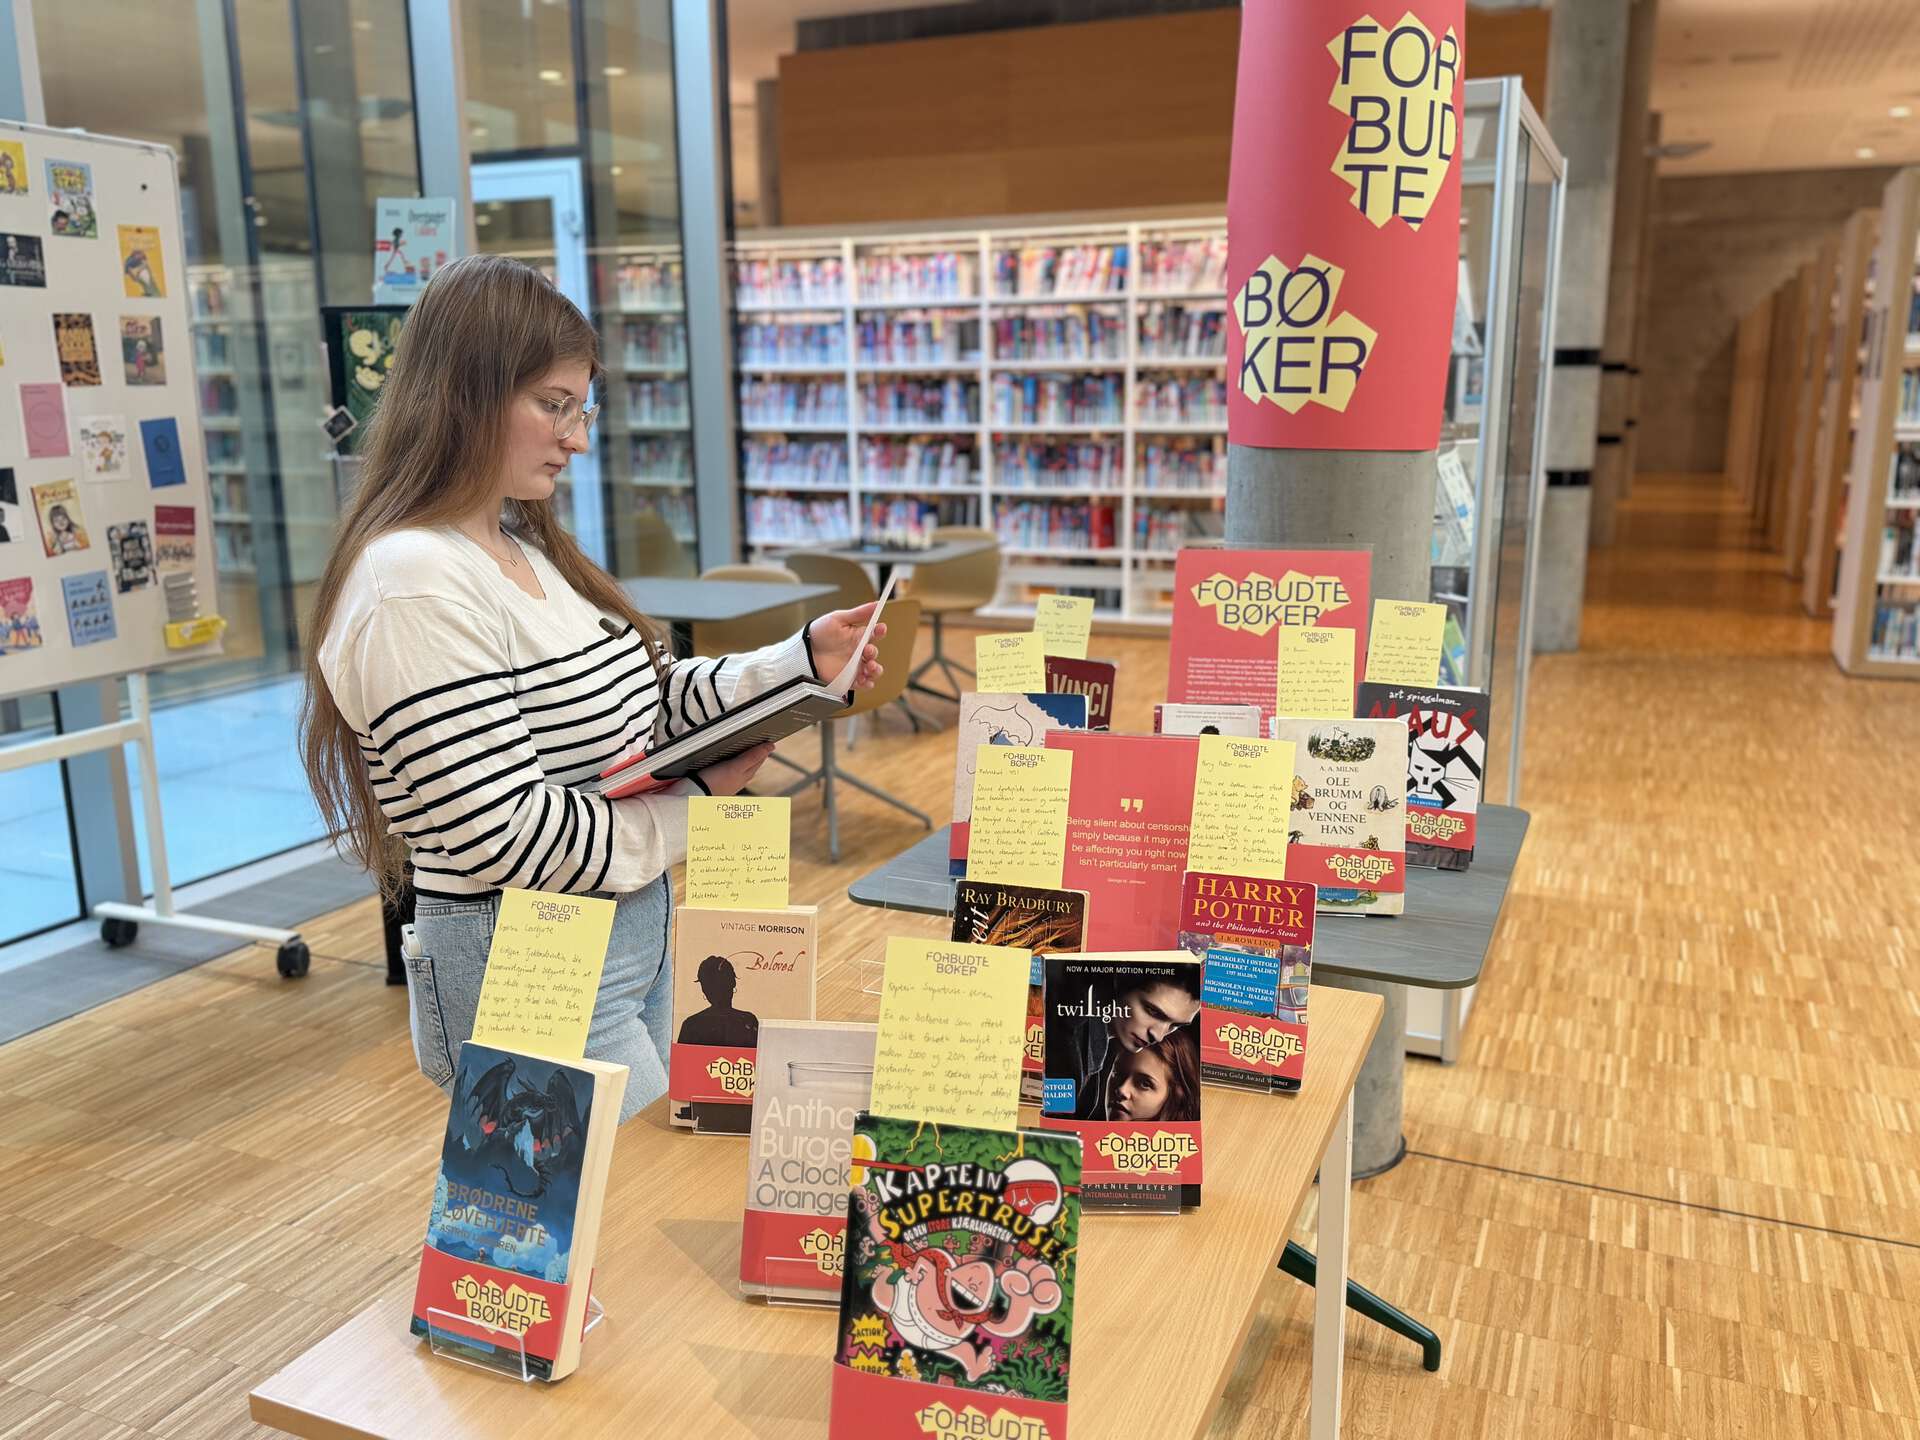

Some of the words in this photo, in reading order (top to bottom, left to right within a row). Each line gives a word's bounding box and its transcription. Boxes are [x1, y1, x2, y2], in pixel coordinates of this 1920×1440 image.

[1341, 26, 1456, 90] FOR
[1347, 96, 1457, 161] BUD
[1344, 164, 1428, 224] TE
[1244, 266, 1331, 328] BØ
[1241, 336, 1366, 394] KER
[1198, 579, 1349, 603] FORBUDTE
[1224, 603, 1320, 626] BØKER
[1389, 689, 1404, 699] art
[1369, 699, 1476, 745] MAUS
[1226, 742, 1269, 753] FORBUDTE
[1003, 753, 1046, 762] FORBUDTE
[1326, 776, 1350, 786] OLE
[1315, 788, 1362, 799] BRUMM
[716, 804, 762, 812] FORBUDTE
[1328, 801, 1347, 810] OG
[1066, 816, 1091, 827] Being
[1093, 818, 1117, 828] silent
[1120, 819, 1145, 830] about
[1308, 812, 1366, 824] VENNENE
[1071, 831, 1101, 842] simply
[1103, 832, 1141, 842] because
[1143, 834, 1149, 843] it
[1151, 837, 1171, 846] may
[1173, 837, 1188, 845] not
[1321, 826, 1354, 835] HANS
[1414, 824, 1454, 838] BØKER
[1071, 844, 1083, 852] be
[1085, 844, 1123, 856] affecting
[1126, 848, 1142, 857] you
[1145, 849, 1165, 859] right
[1167, 851, 1187, 859] now
[1079, 857, 1098, 866] isn't
[1099, 860, 1148, 872] particularly
[1151, 863, 1177, 871] smart
[1328, 856, 1395, 871] FORBUDTE
[1340, 867, 1383, 880] BØKER
[1197, 877, 1305, 906] HARRY
[531, 901, 581, 915] FORBUDTE
[1192, 898, 1305, 928] POTTER
[720, 922, 757, 933] VINTAGE
[758, 923, 805, 935] MORRISON
[1195, 919, 1211, 927] and
[1212, 921, 1225, 929] the
[1226, 923, 1275, 936] Philosopher's
[1276, 929, 1298, 938] Stone
[731, 950, 805, 974] Beloved
[926, 952, 990, 968] FORBUDTE
[936, 963, 977, 977] BØKER
[1252, 967, 1277, 975] HALDEN
[1056, 984, 1132, 1023] twilight
[1248, 993, 1273, 1002] HALDEN
[1219, 1025, 1303, 1052] FORBUDTE
[1232, 1042, 1287, 1062] BØKER
[710, 1061, 755, 1077] FORB
[724, 1075, 756, 1091] BØK
[1245, 1074, 1265, 1083] Award
[761, 1096, 855, 1131] Antho
[759, 1128, 850, 1167] Burge
[1099, 1137, 1198, 1152] FORBUDTE
[1118, 1153, 1181, 1169] BØKER
[757, 1160, 775, 1182] A
[780, 1160, 850, 1186] Clock
[875, 1164, 1002, 1203] KAPTEIN
[448, 1181, 538, 1220] BRØDRENE
[756, 1183, 848, 1215] Orange
[442, 1200, 545, 1247] LØVEHJERTE
[879, 1190, 1061, 1258] SUPERTRUSE
[913, 1223, 927, 1238] DEN
[951, 1217, 1013, 1243] KJÆRLIGHETEN
[456, 1279, 551, 1319] FORBUDTE
[470, 1301, 531, 1332] BØKER
[856, 1328, 884, 1337] ACTION!
[921, 1407, 1048, 1440] FORBUDTE
